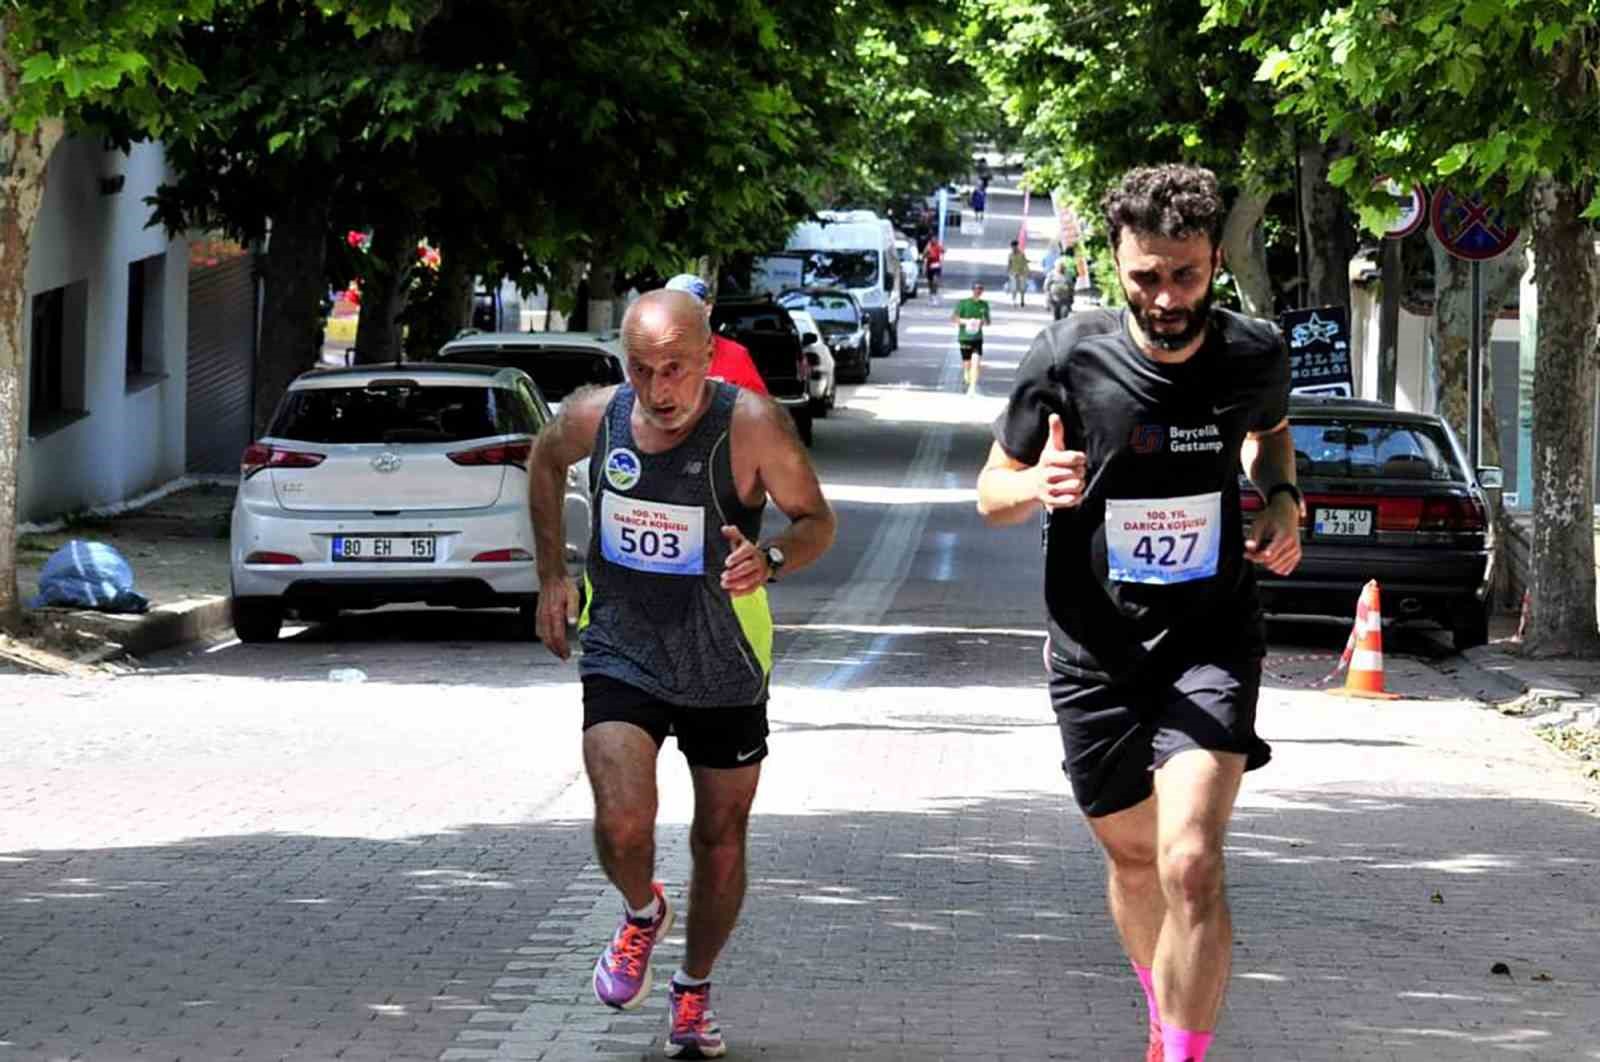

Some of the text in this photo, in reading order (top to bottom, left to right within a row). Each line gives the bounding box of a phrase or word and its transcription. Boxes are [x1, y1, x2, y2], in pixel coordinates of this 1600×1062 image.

[1169, 424, 1220, 441] Beyçelik
[1170, 438, 1223, 453] Gestamp
[613, 512, 648, 526] DARICA
[1323, 510, 1367, 522] 34 KU
[1123, 521, 1165, 531] DARICA
[1333, 521, 1356, 534] 738
[344, 540, 432, 555] 80 EH 151
[619, 528, 680, 558] 503
[1133, 532, 1199, 566] 427
